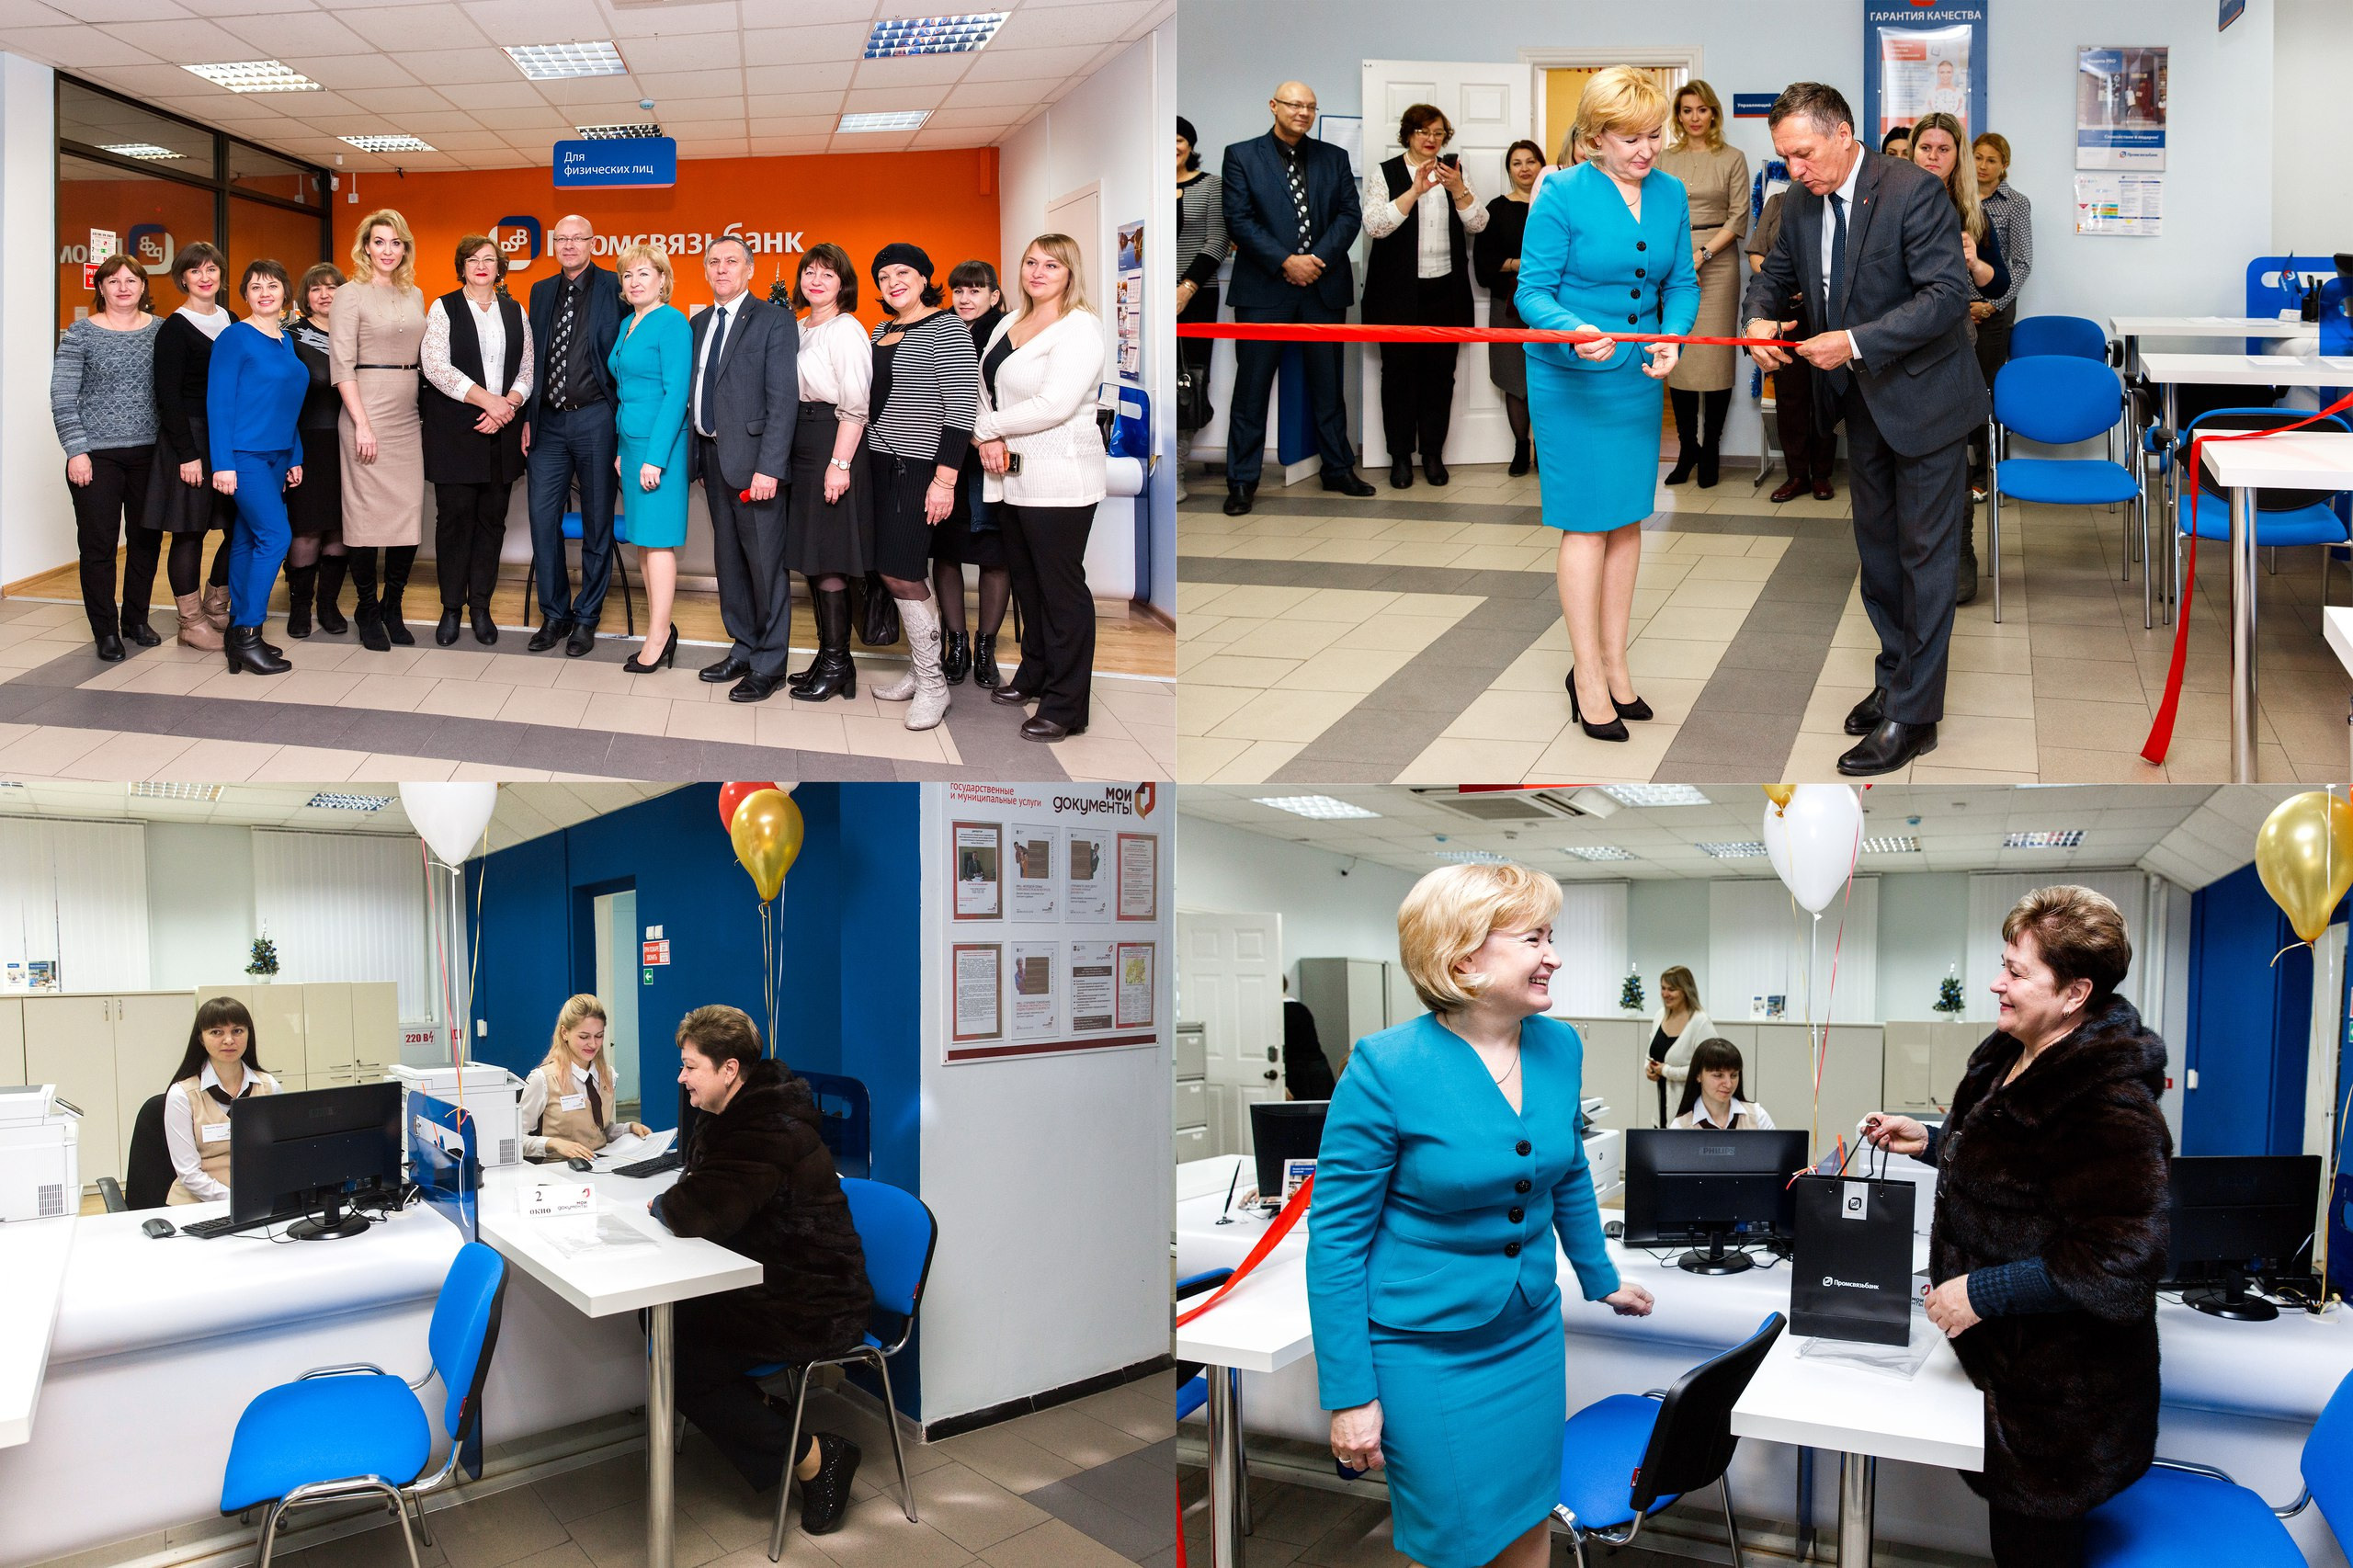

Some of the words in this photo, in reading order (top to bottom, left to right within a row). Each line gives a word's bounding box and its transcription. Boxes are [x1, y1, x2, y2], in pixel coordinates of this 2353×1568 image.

[1870, 12, 1925, 21] ГАРАНТИЯ
[1927, 10, 1982, 20] КАЧЕСТВА
[564, 152, 585, 164] Для
[564, 165, 631, 177] физических
[632, 165, 654, 176] лиц
[950, 783, 1015, 796] государственные
[958, 792, 1017, 805] муниципальные
[1018, 798, 1042, 808] услуги
[1052, 796, 1132, 815] документы
[405, 1034, 422, 1043] 220
[535, 1190, 543, 1202] 2
[1834, 1278, 1880, 1290] Промсвязьбанк
